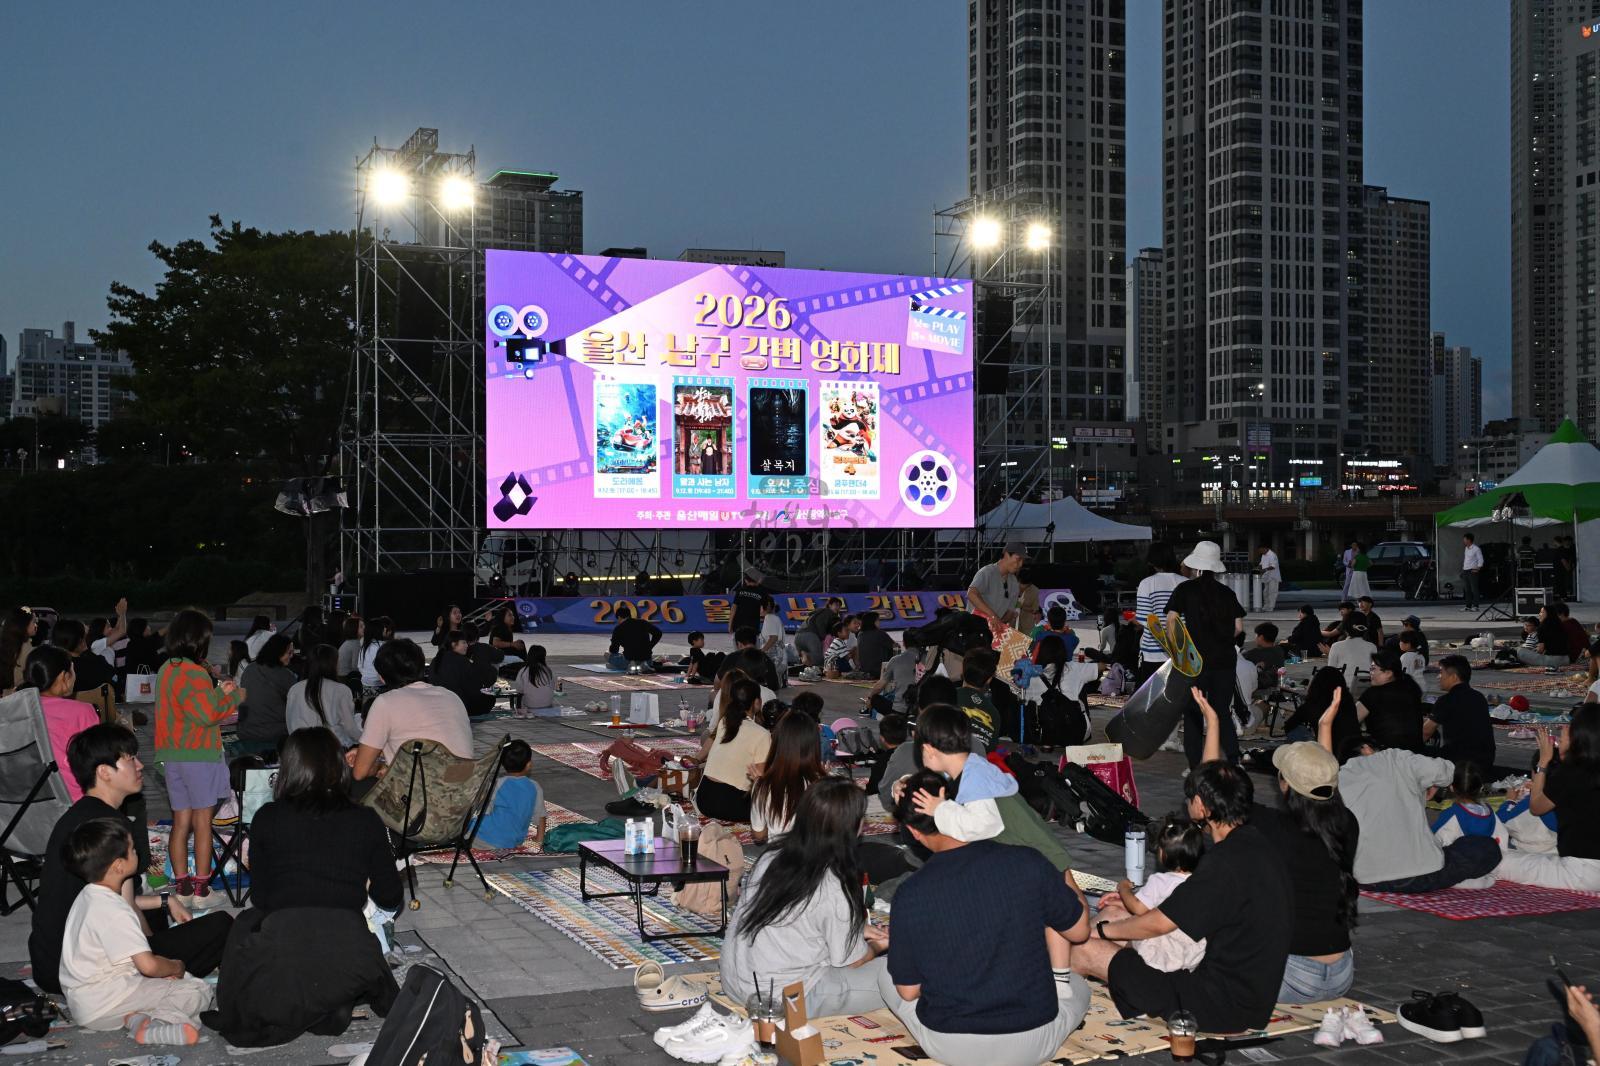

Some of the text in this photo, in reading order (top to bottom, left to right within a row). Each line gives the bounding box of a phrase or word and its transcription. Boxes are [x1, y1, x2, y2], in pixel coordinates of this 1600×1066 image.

[694, 291, 792, 331] 2026
[932, 321, 960, 335] PLAY
[582, 329, 901, 375] 울산 남구 강변 영화제
[760, 458, 795, 472] 살목지
[590, 598, 685, 624] 2026
